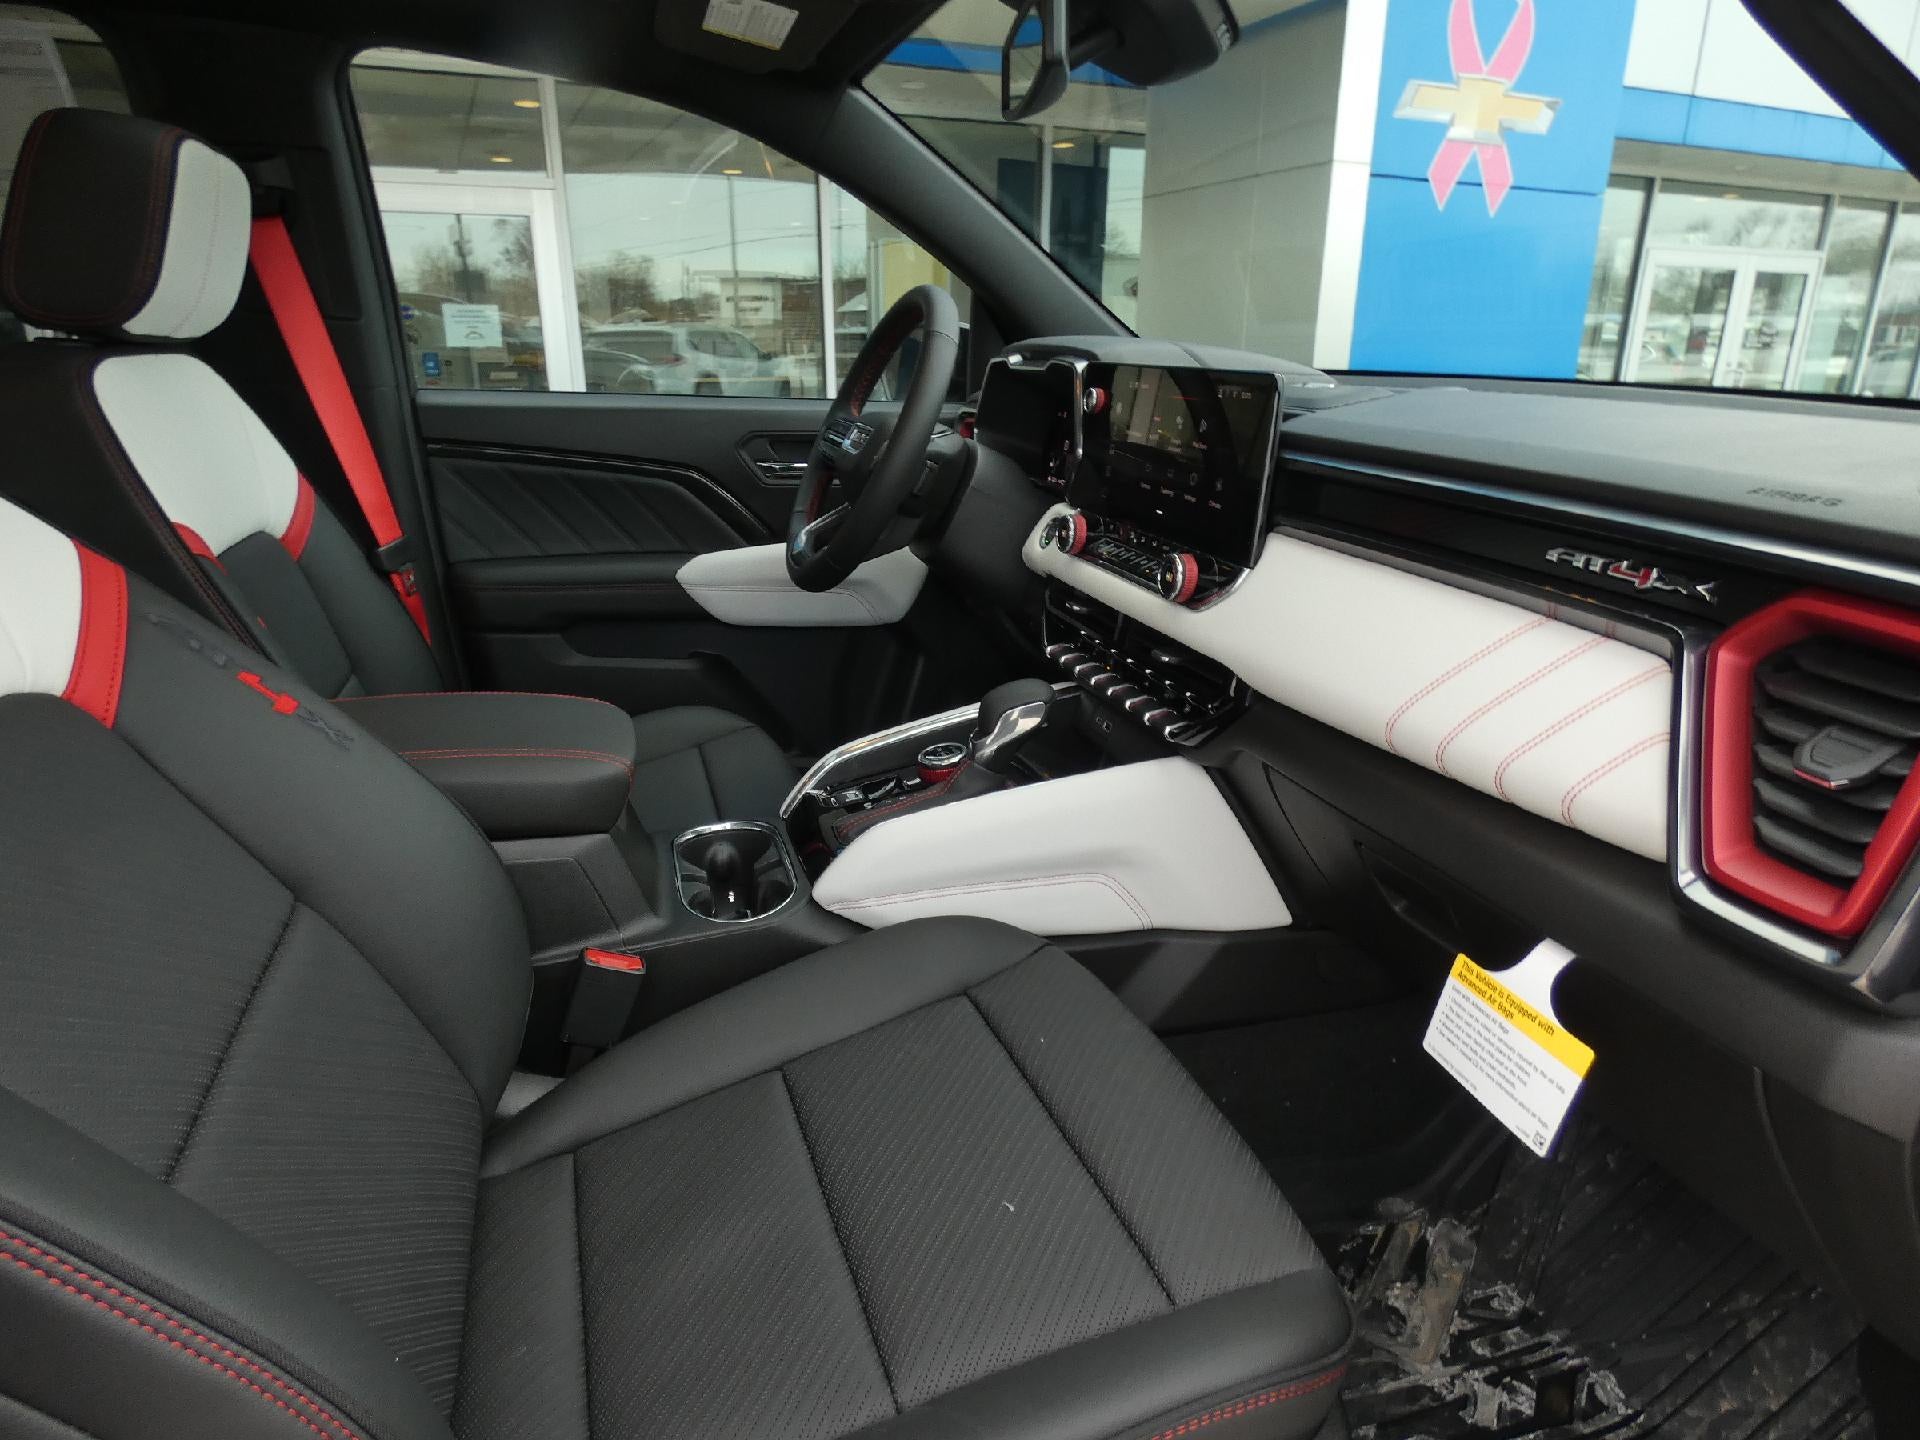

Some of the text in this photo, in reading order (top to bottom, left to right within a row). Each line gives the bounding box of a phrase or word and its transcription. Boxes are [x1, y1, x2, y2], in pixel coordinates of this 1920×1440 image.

[1545, 547, 1716, 603] AT4X
[1458, 971, 1515, 1020] Advanced Air Bags
[1462, 960, 1555, 1036] This Vehicle is Equipped with
